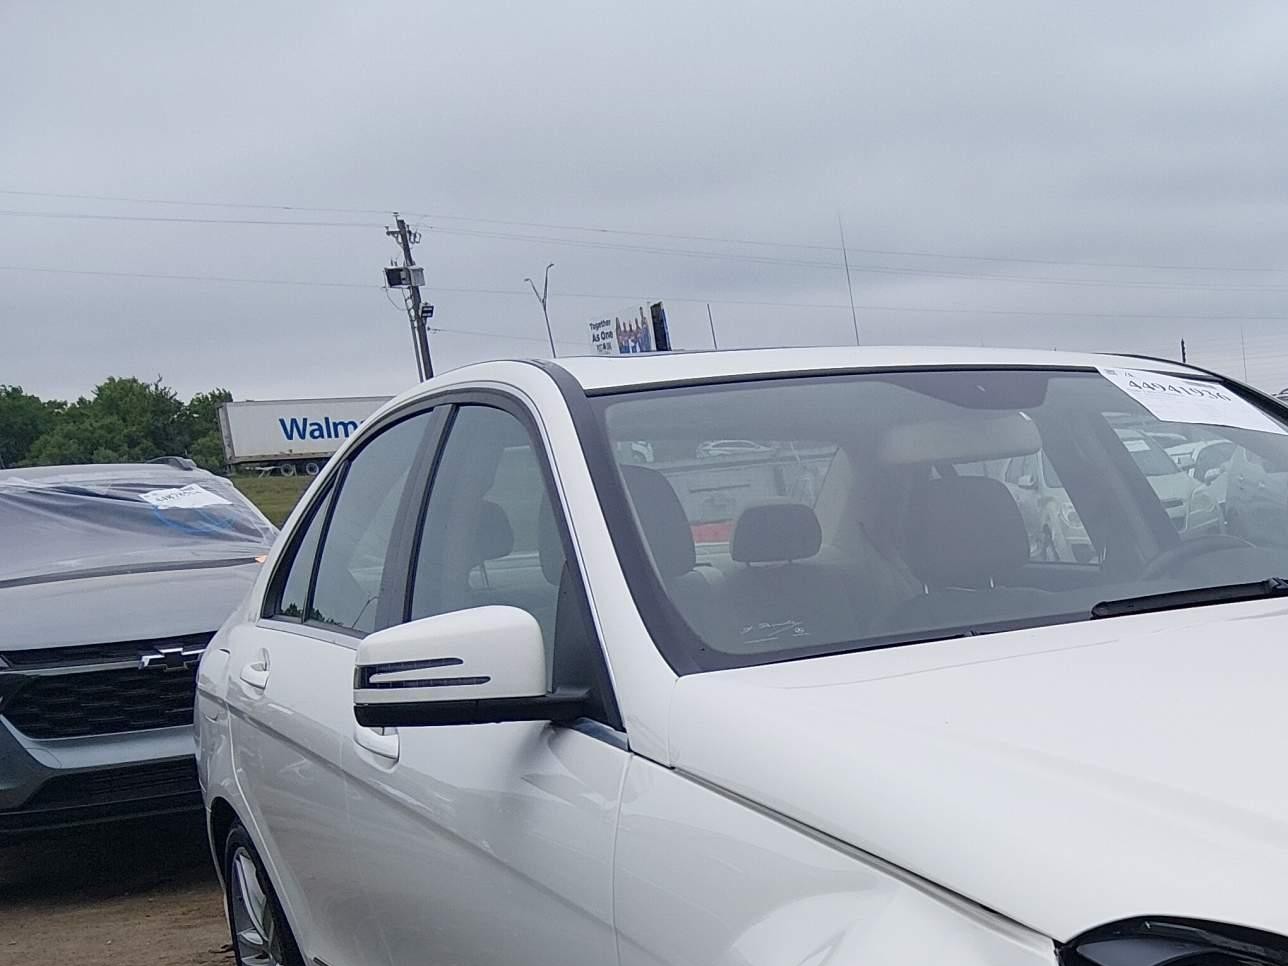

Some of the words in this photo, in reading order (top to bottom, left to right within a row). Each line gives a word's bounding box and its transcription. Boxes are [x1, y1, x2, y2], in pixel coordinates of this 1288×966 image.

[592, 333, 600, 343] As
[600, 330, 613, 341] One
[1127, 379, 1232, 402] 44941936
[279, 416, 364, 441] Walm
